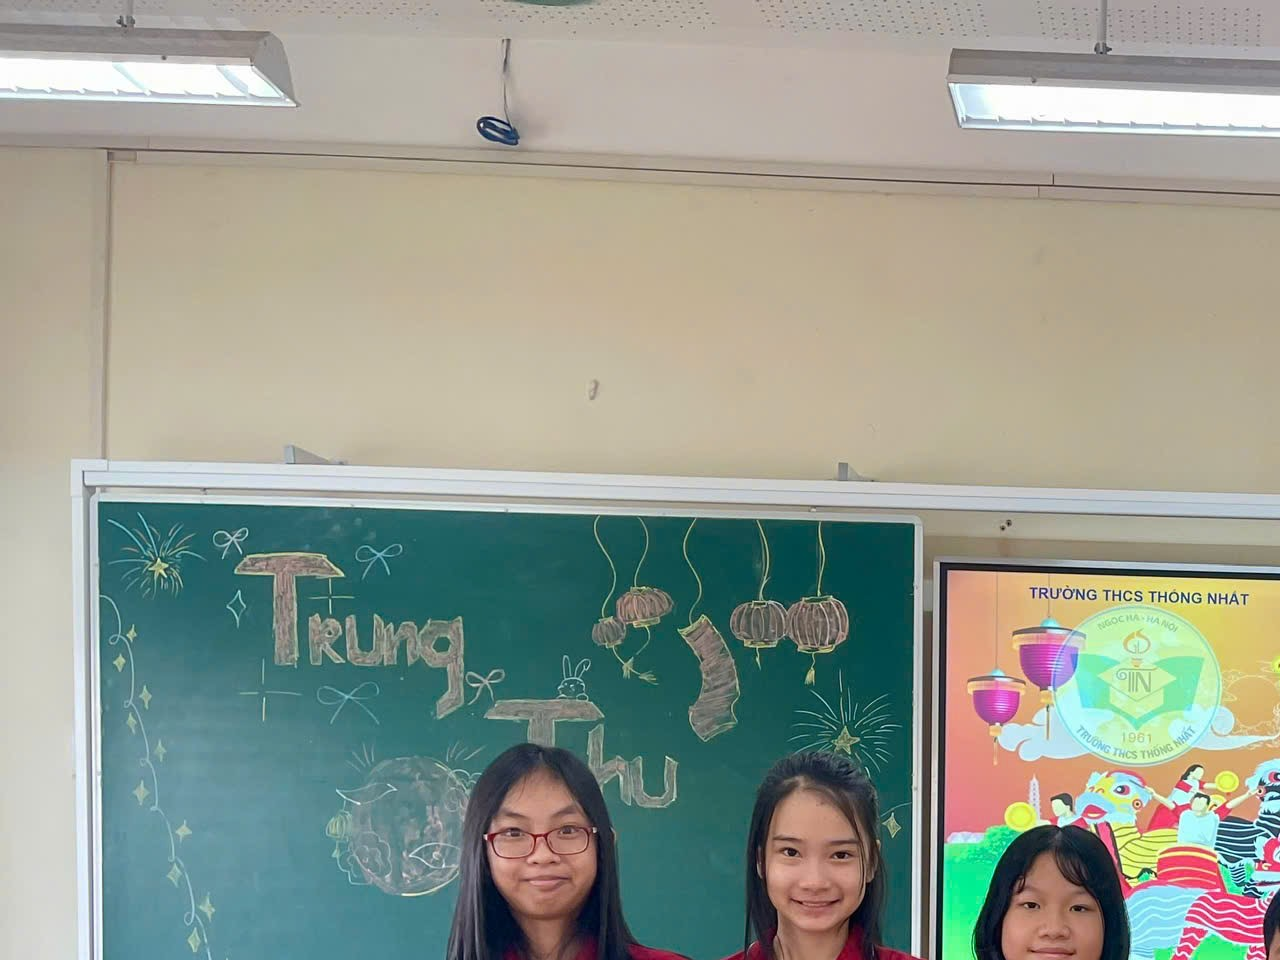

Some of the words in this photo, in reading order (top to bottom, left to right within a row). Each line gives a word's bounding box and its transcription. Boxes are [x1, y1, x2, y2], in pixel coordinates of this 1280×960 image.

[1029, 585, 1098, 601] TRƯỜNG
[1103, 589, 1143, 602] THCS
[1122, 732, 1152, 743] 1961
[1112, 747, 1138, 760] THCS
